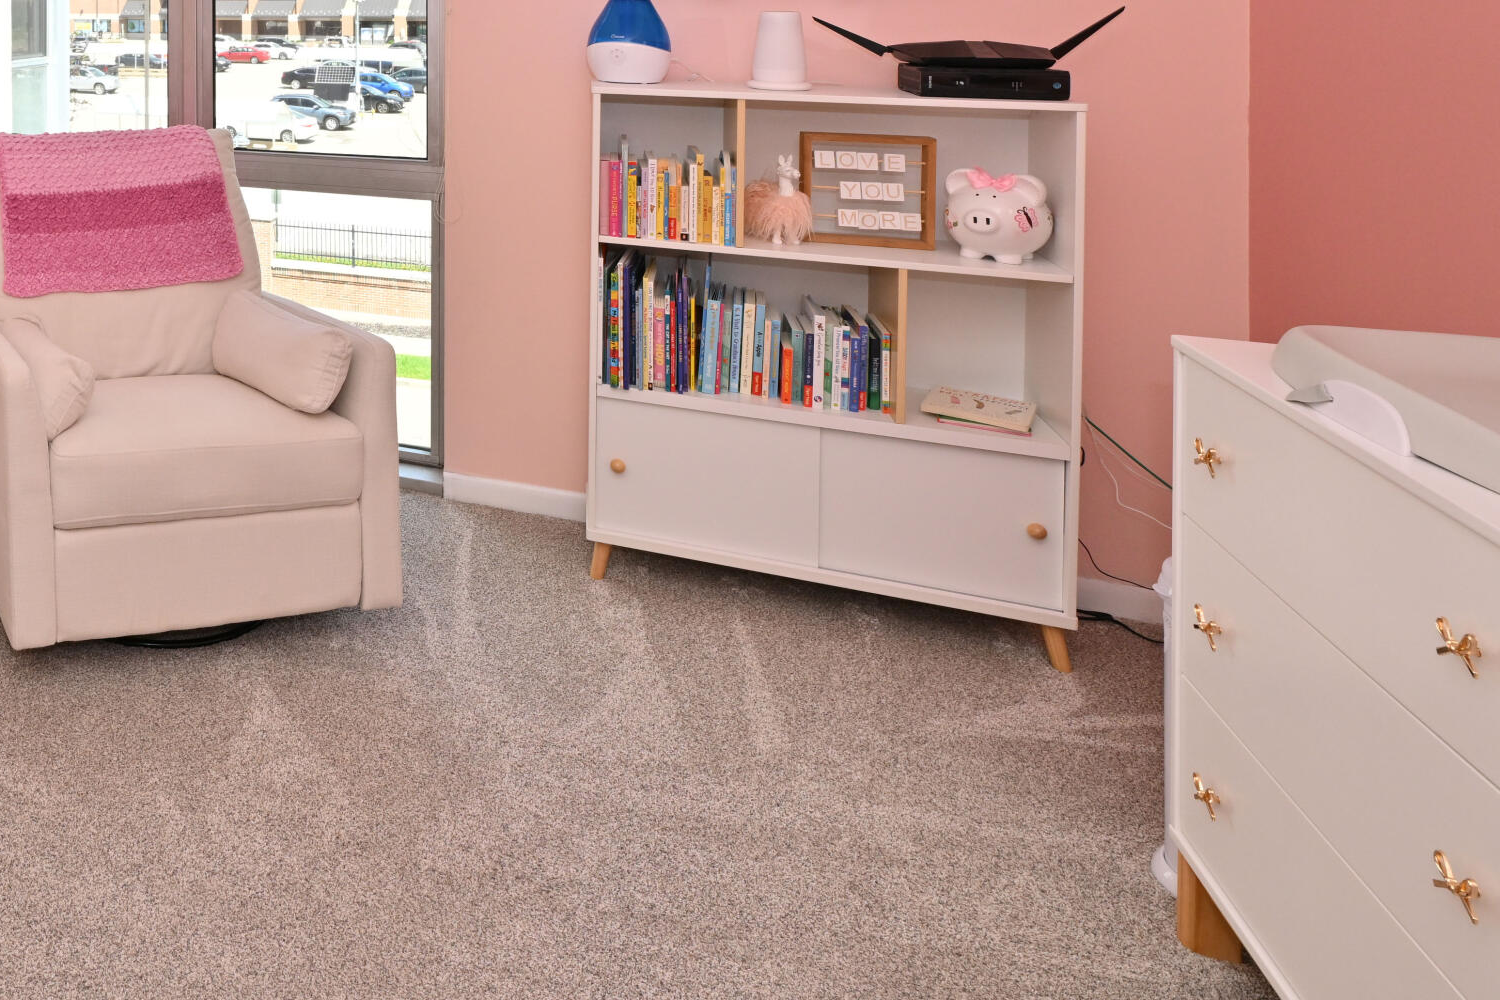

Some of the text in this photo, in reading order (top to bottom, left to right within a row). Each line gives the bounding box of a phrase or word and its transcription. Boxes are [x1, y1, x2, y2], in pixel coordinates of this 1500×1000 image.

[819, 152, 901, 170] LOVE
[843, 183, 901, 199] YOU
[840, 211, 918, 229] MORE
